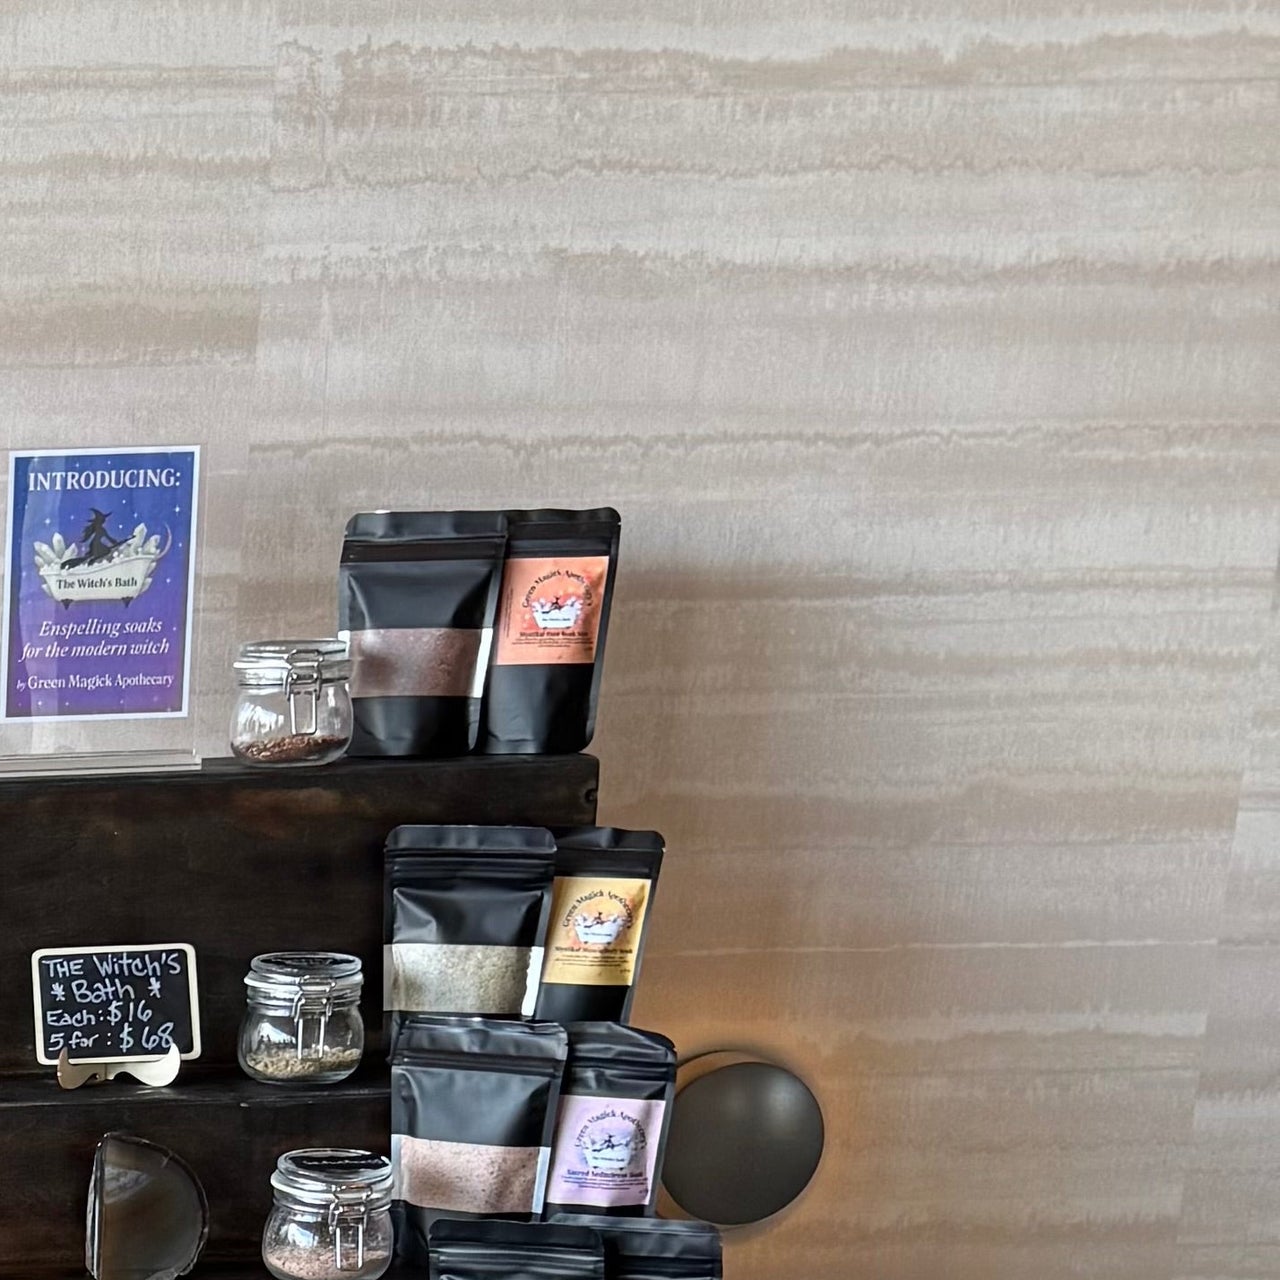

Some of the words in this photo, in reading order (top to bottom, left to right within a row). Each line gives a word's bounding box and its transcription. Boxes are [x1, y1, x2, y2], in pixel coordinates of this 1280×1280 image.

[28, 469, 181, 491] INTRODUCING:
[55, 578, 75, 590] The
[76, 577, 112, 589] Witch's
[114, 577, 138, 588] Bath
[39, 619, 122, 638] Enspelling
[123, 617, 162, 634] soaks
[19, 643, 43, 663] for
[45, 642, 68, 658] the
[70, 641, 127, 657] modern
[129, 638, 170, 655] witch
[27, 676, 66, 690] Green
[68, 674, 113, 690] Magick
[114, 673, 174, 688] Apothecary
[42, 958, 84, 978] THE
[93, 952, 181, 977] Witch's
[72, 978, 135, 1003] Bath
[106, 1000, 153, 1026] $16
[48, 1033, 65, 1051] 5
